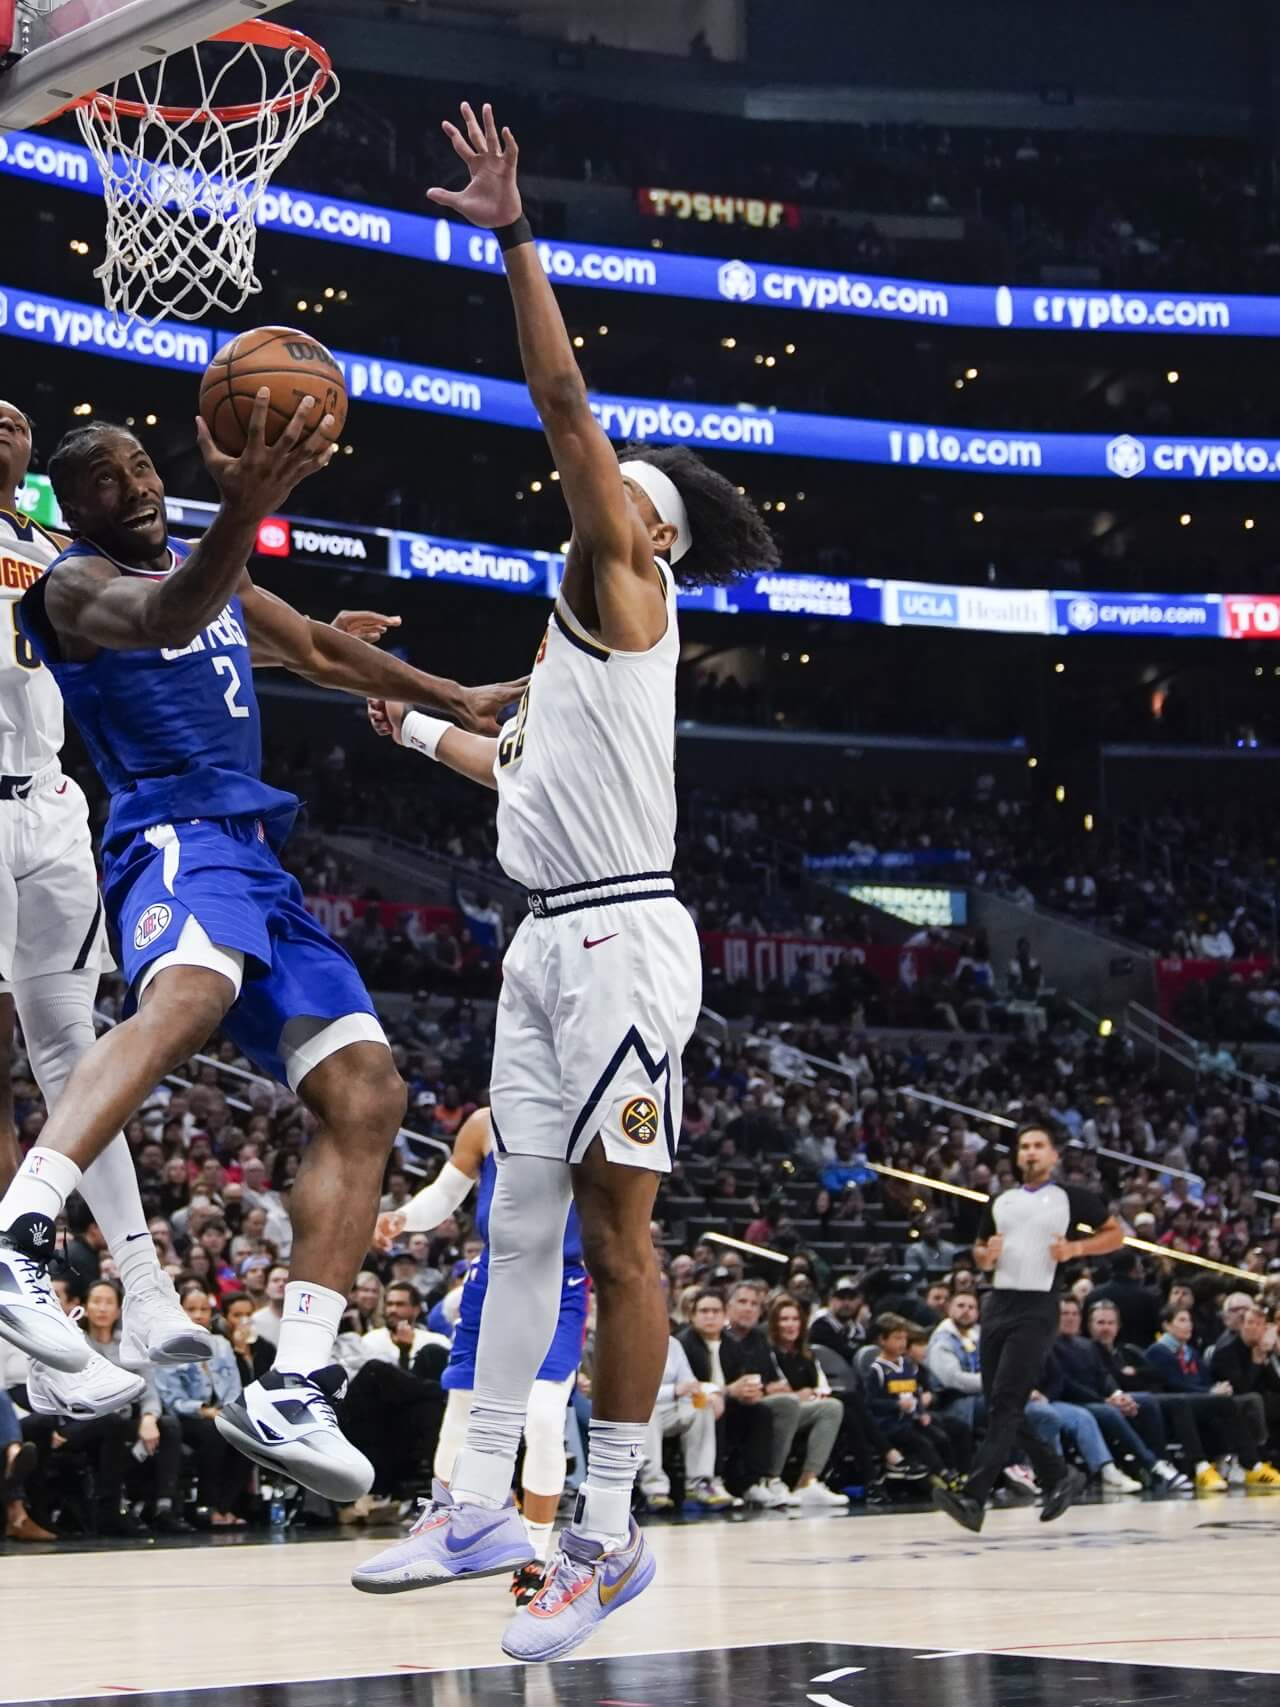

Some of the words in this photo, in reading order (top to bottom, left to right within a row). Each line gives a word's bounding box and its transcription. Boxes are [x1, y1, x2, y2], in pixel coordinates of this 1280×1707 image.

[763, 272, 948, 317] crypto.com
[1033, 294, 1229, 329] crypto.com
[14, 300, 209, 364] crypto.com
[1153, 442, 1280, 478] crypto.
[292, 530, 366, 558] TOYOTA
[410, 541, 528, 583] Spectrum
[903, 595, 953, 616] UCLA
[1099, 604, 1206, 625] crypto.com
[211, 656, 250, 718] 2
